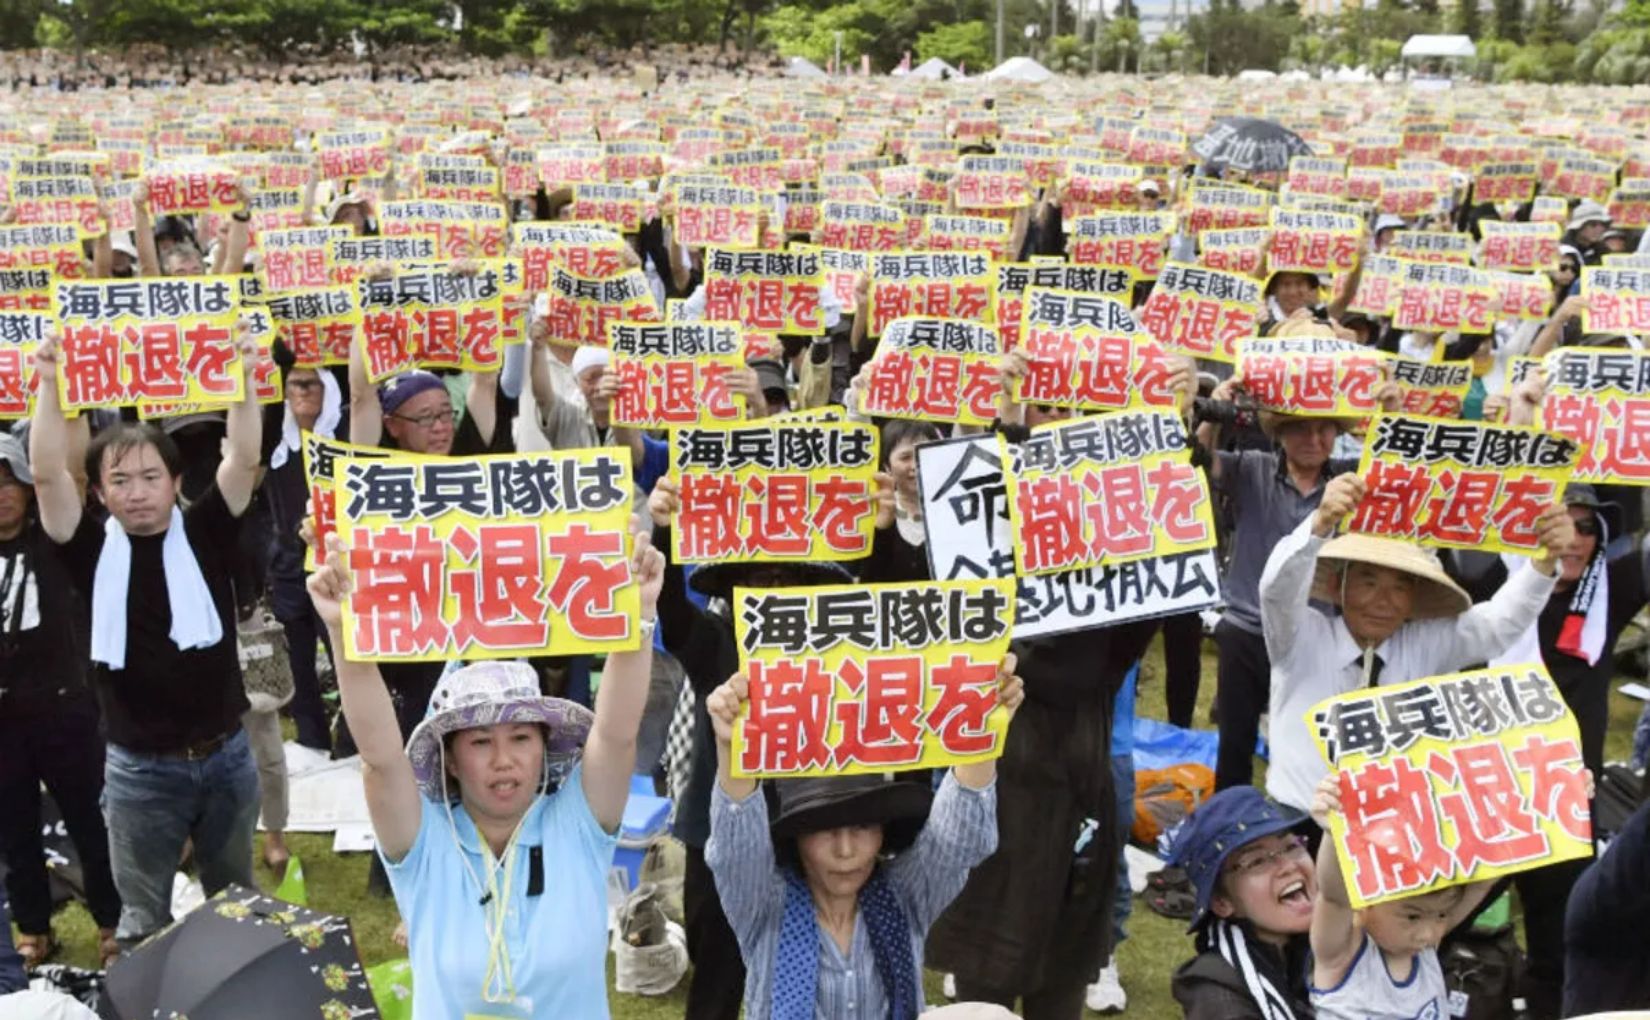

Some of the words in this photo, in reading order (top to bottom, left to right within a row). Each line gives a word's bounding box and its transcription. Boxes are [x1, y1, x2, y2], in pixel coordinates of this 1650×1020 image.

[16, 179, 94, 197] 海兵隊は
[148, 172, 239, 212] 撤退を
[425, 169, 494, 184] 海兵隊は
[679, 187, 756, 203] 海兵隊は
[677, 207, 756, 243] 撤退を
[825, 204, 900, 223] 海兵隊は
[1076, 217, 1162, 236] 海兵隊は
[1278, 212, 1355, 229] 海兵隊は
[333, 239, 434, 261] 海兵隊は
[821, 222, 898, 250] 撤退を
[1270, 231, 1358, 268] 撤退を
[1485, 235, 1558, 267] 撤退を
[709, 249, 820, 276] 海兵隊は
[874, 255, 987, 279] 海兵隊は
[1074, 240, 1162, 275] 撤退を
[1404, 262, 1489, 286] 海兵隊は
[359, 272, 499, 307] 海兵隊は
[552, 268, 647, 302] 海兵隊は
[998, 266, 1130, 293] 海兵隊は
[1161, 265, 1259, 301] 海兵隊は
[58, 281, 231, 320] 海兵隊は
[266, 290, 352, 320] 兵隊は
[704, 278, 820, 329] 撤退を
[873, 282, 987, 334] 撤退を
[1396, 287, 1490, 329] 撤退を
[362, 307, 499, 377] 撤退を
[610, 324, 738, 357] 海兵隊は
[1141, 292, 1254, 355] 撤退を
[61, 323, 236, 403] 撤退を
[1020, 329, 1176, 406] 撤退を
[1242, 355, 1379, 410] 撤退を
[612, 360, 741, 424] 撤退を
[865, 351, 1002, 418] 撤退を
[677, 428, 872, 469] 海兵隊は
[1009, 413, 1187, 472] 海兵隊は
[1371, 416, 1576, 467] 海兵隊は
[346, 457, 628, 519] 海兵隊は
[1349, 460, 1554, 547] 撤退を
[678, 473, 871, 558] 撤退を
[1016, 461, 1206, 570] 撤退を
[349, 524, 632, 655] 撤退を
[742, 588, 1008, 653] 海兵隊は
[741, 655, 1000, 772] 撤退を
[1314, 671, 1565, 766] 海兵隊は
[1338, 736, 1593, 899] 撤退を
